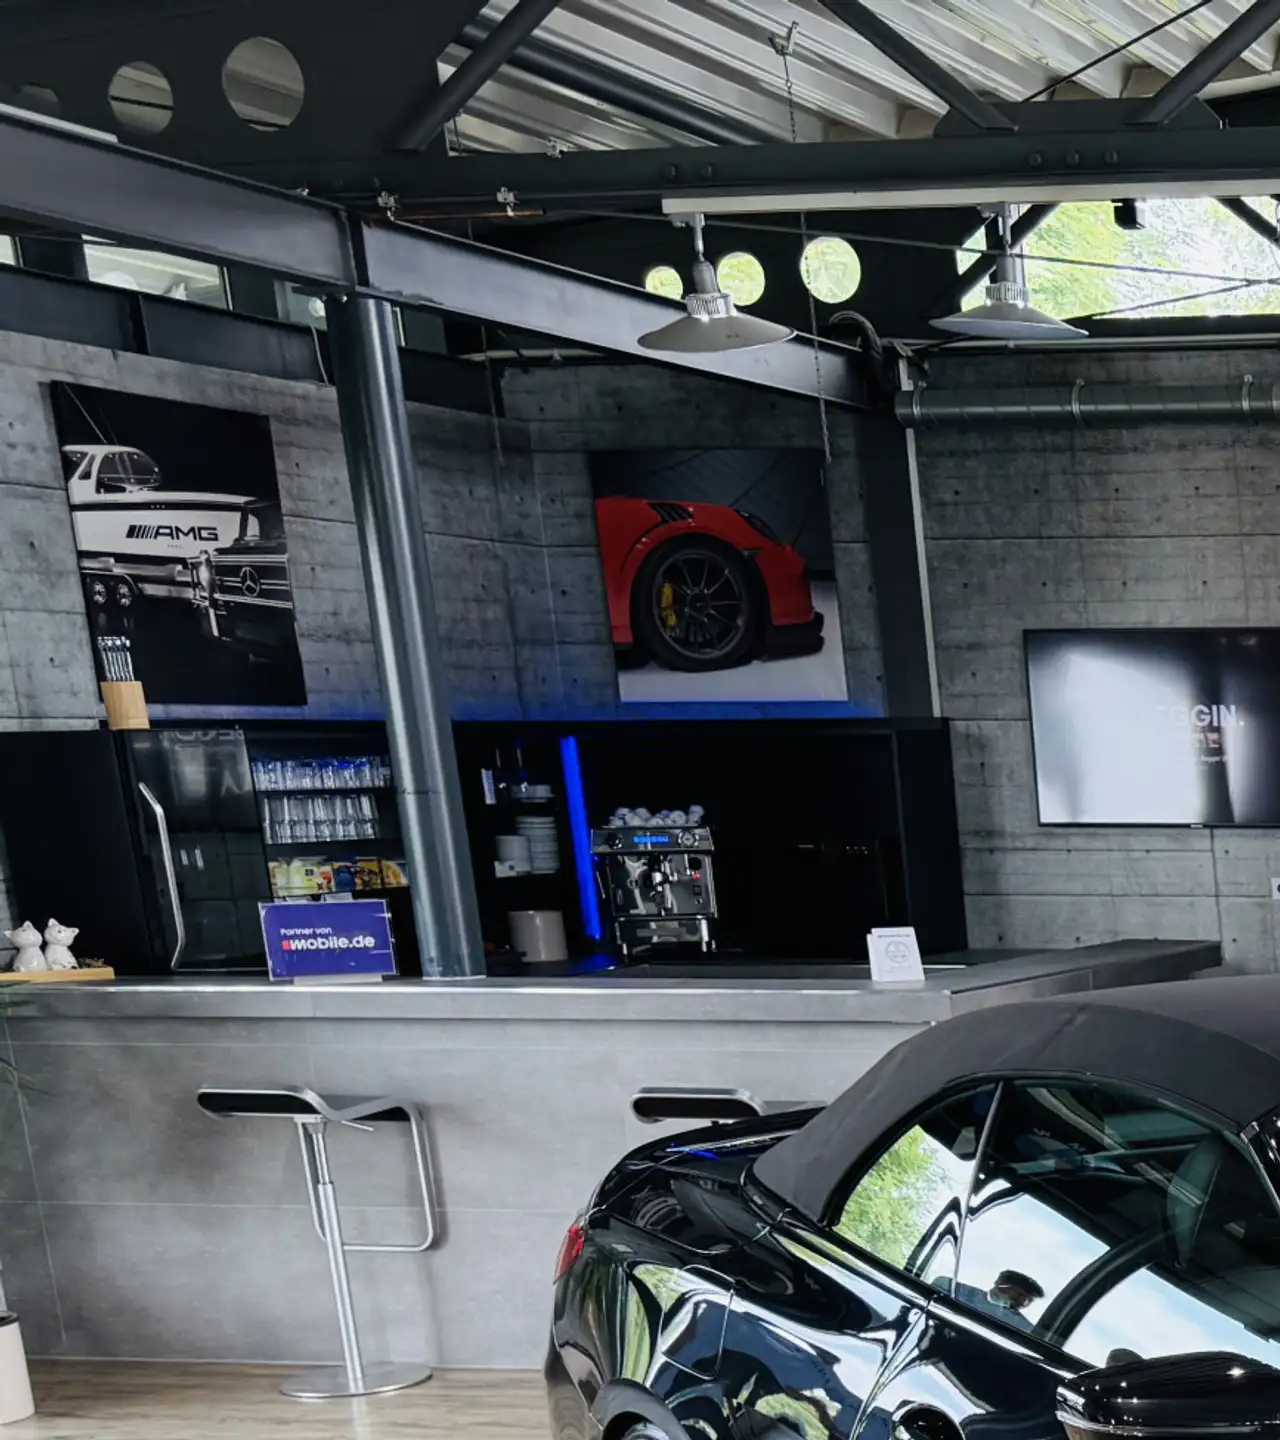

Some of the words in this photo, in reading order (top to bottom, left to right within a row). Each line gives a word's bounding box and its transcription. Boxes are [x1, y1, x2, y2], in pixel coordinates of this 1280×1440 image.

[153, 525, 219, 542] AMG
[280, 927, 313, 937] Partner
[314, 927, 333, 936] von
[290, 935, 375, 950] mobile.de
